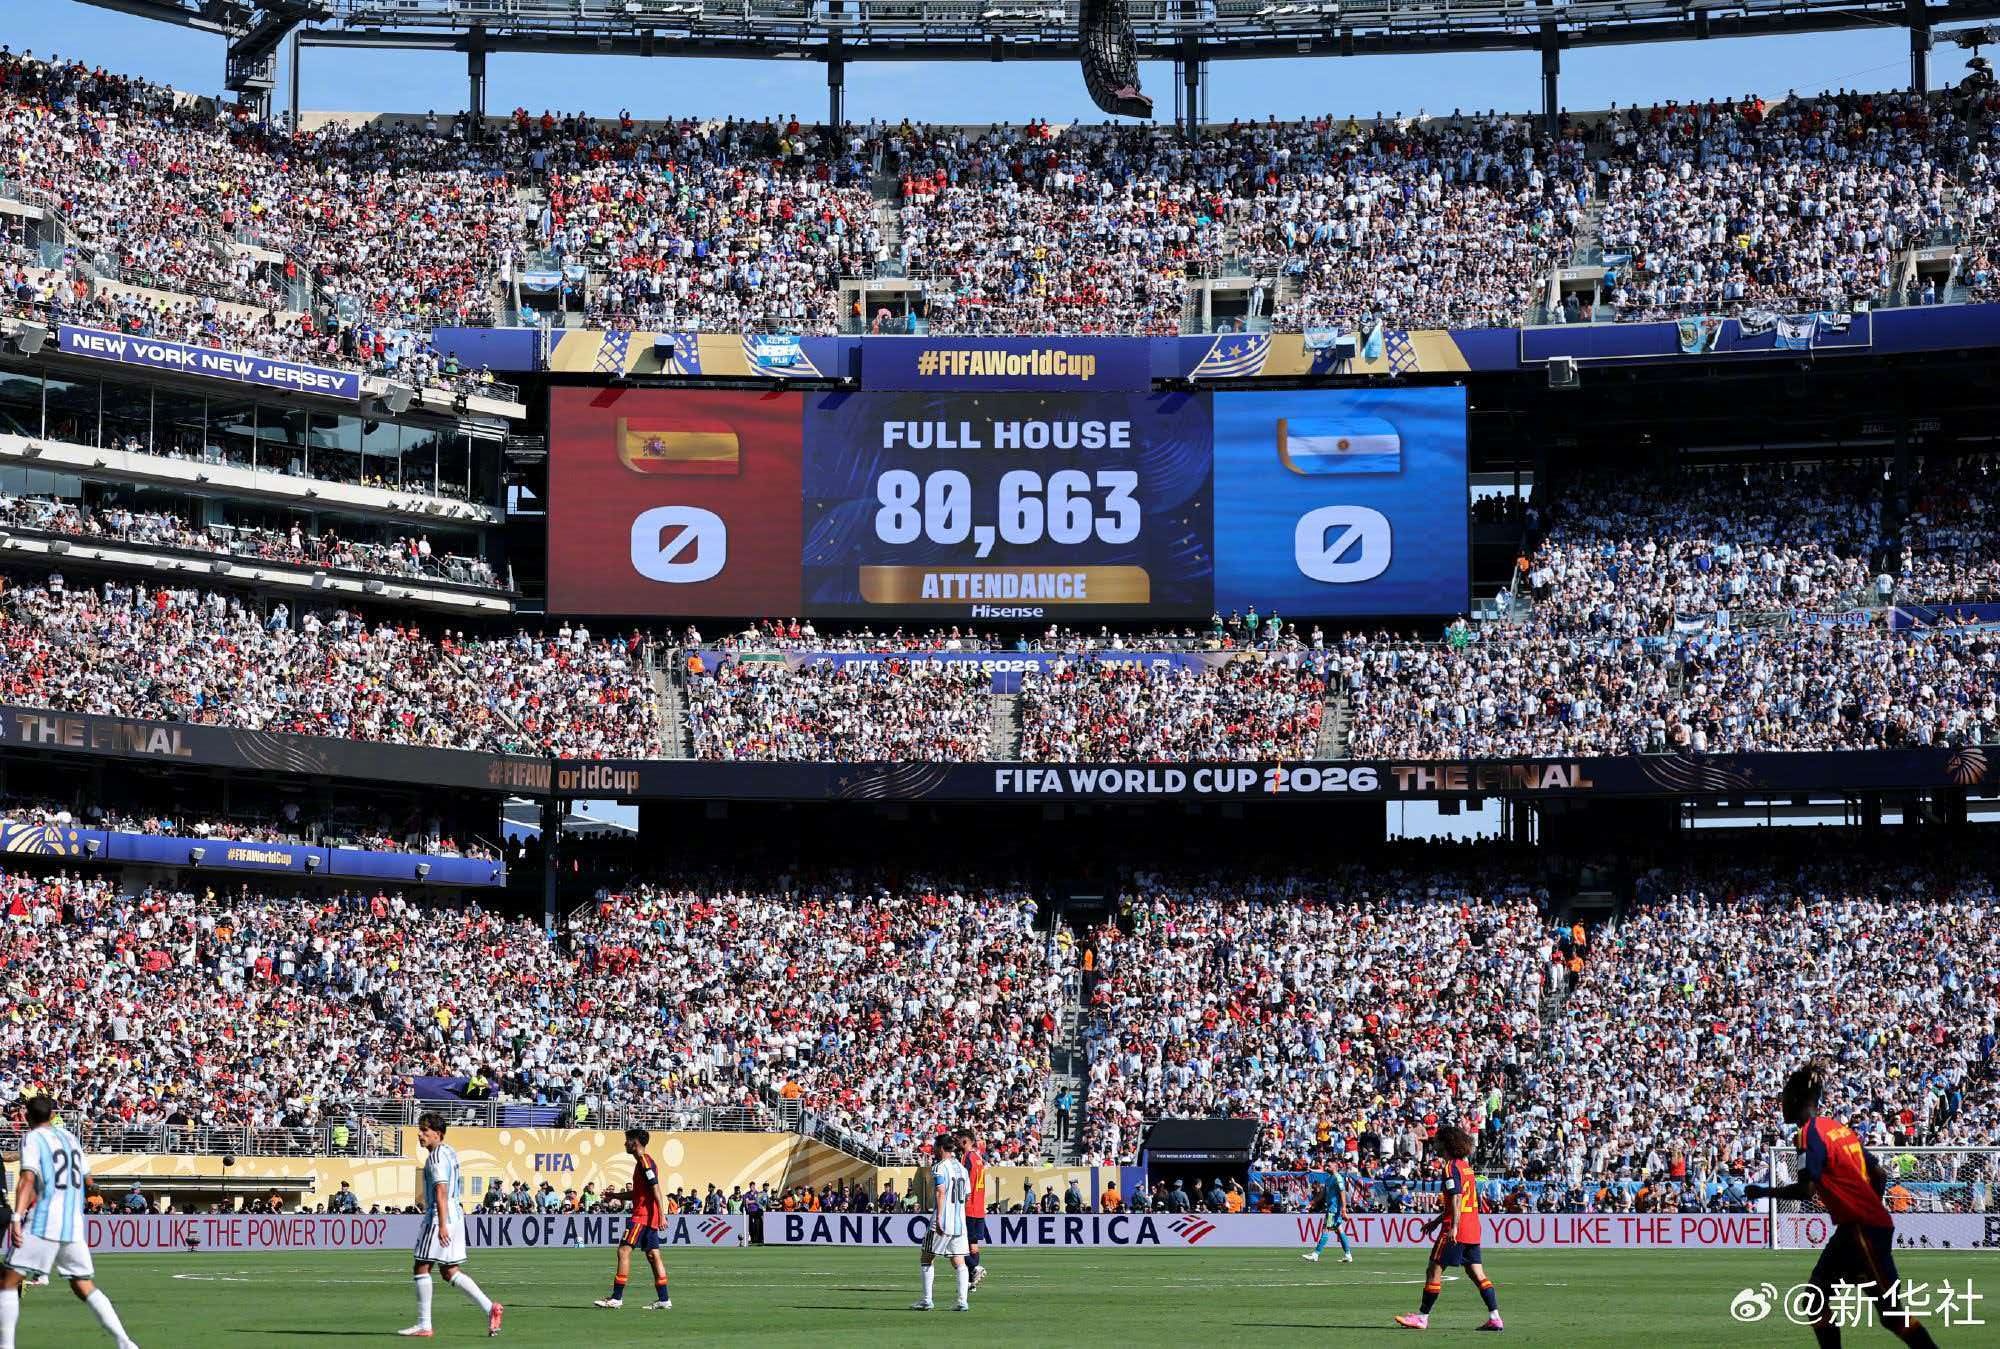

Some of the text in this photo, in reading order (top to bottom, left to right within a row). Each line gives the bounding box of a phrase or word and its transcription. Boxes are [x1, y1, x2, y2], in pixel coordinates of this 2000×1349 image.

[72, 333, 346, 390] NEW YORK NEW JERSEY
[917, 350, 1096, 381] #FIFAWorldCup
[883, 421, 1131, 449] FULL HOUSE
[875, 469, 1141, 558] 80,663
[631, 505, 726, 583] 0
[1295, 505, 1391, 583] 0
[921, 573, 1087, 599] ATTENDANCE
[971, 605, 1044, 618] Hisense
[980, 659, 1040, 673] 2026
[15, 714, 86, 748] THE
[91, 720, 193, 757] FINAL
[995, 764, 1594, 793] FIFA WORLD CUP 2026 THE FINAL
[227, 848, 292, 866] #FIFAWorldCup
[534, 1153, 574, 1172] FIFA
[951, 1176, 966, 1204] 10
[107, 1220, 151, 1248] YOU
[156, 1219, 200, 1247] LIKE
[204, 1220, 242, 1247] THE
[248, 1219, 315, 1247] POWER
[319, 1219, 347, 1247] TO
[350, 1219, 387, 1246] DO?
[521, 1217, 555, 1246] OF
[785, 1215, 893, 1245] BANK
[1297, 1217, 1375, 1243] WAT
[1489, 1218, 1545, 1244] YOU
[1554, 1218, 1609, 1243] LIKE
[1616, 1218, 1671, 1243] THE
[1788, 1217, 1827, 1245] TO
